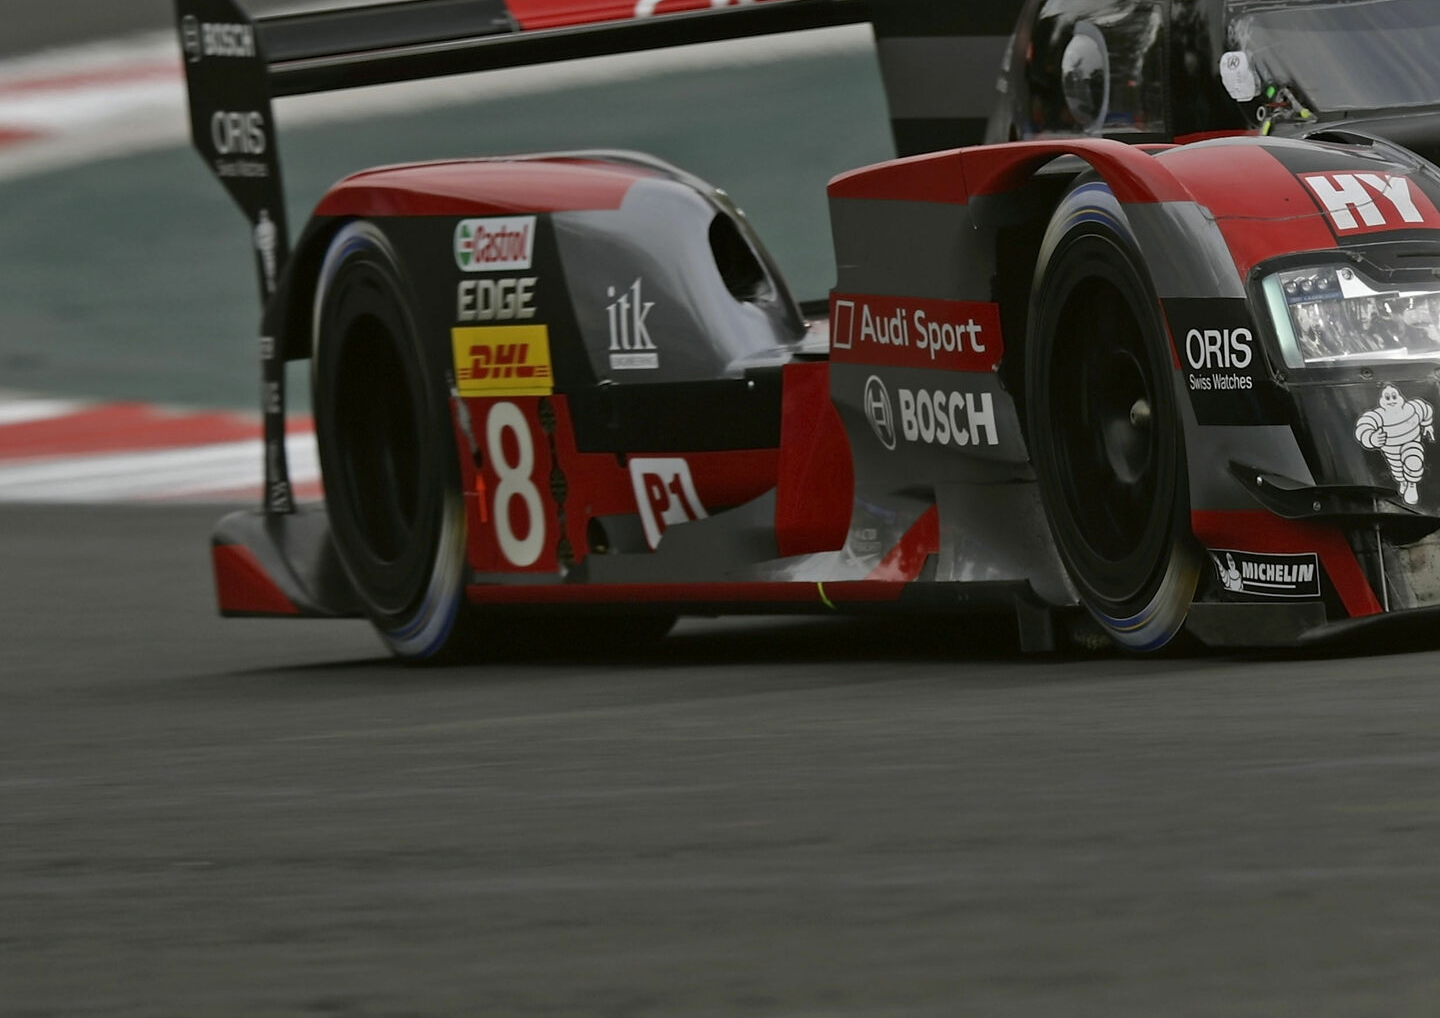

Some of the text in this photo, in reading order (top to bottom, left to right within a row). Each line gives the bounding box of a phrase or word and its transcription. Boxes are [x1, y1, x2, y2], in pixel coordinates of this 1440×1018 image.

[202, 22, 256, 57] BOSCH
[211, 110, 267, 155] ORIS
[1304, 173, 1425, 230] HY
[473, 224, 530, 264] Castrol
[457, 277, 539, 322] EDGE
[606, 276, 658, 351] itk
[860, 304, 986, 360] Audi Sport
[1186, 327, 1253, 370] ORIS
[469, 343, 537, 380] DHL
[1189, 373, 1253, 390] Swiss Watches
[898, 388, 999, 446] BOSCH
[486, 401, 546, 567] 8
[642, 472, 697, 536] P1
[1242, 561, 1314, 582] MICHELIN
